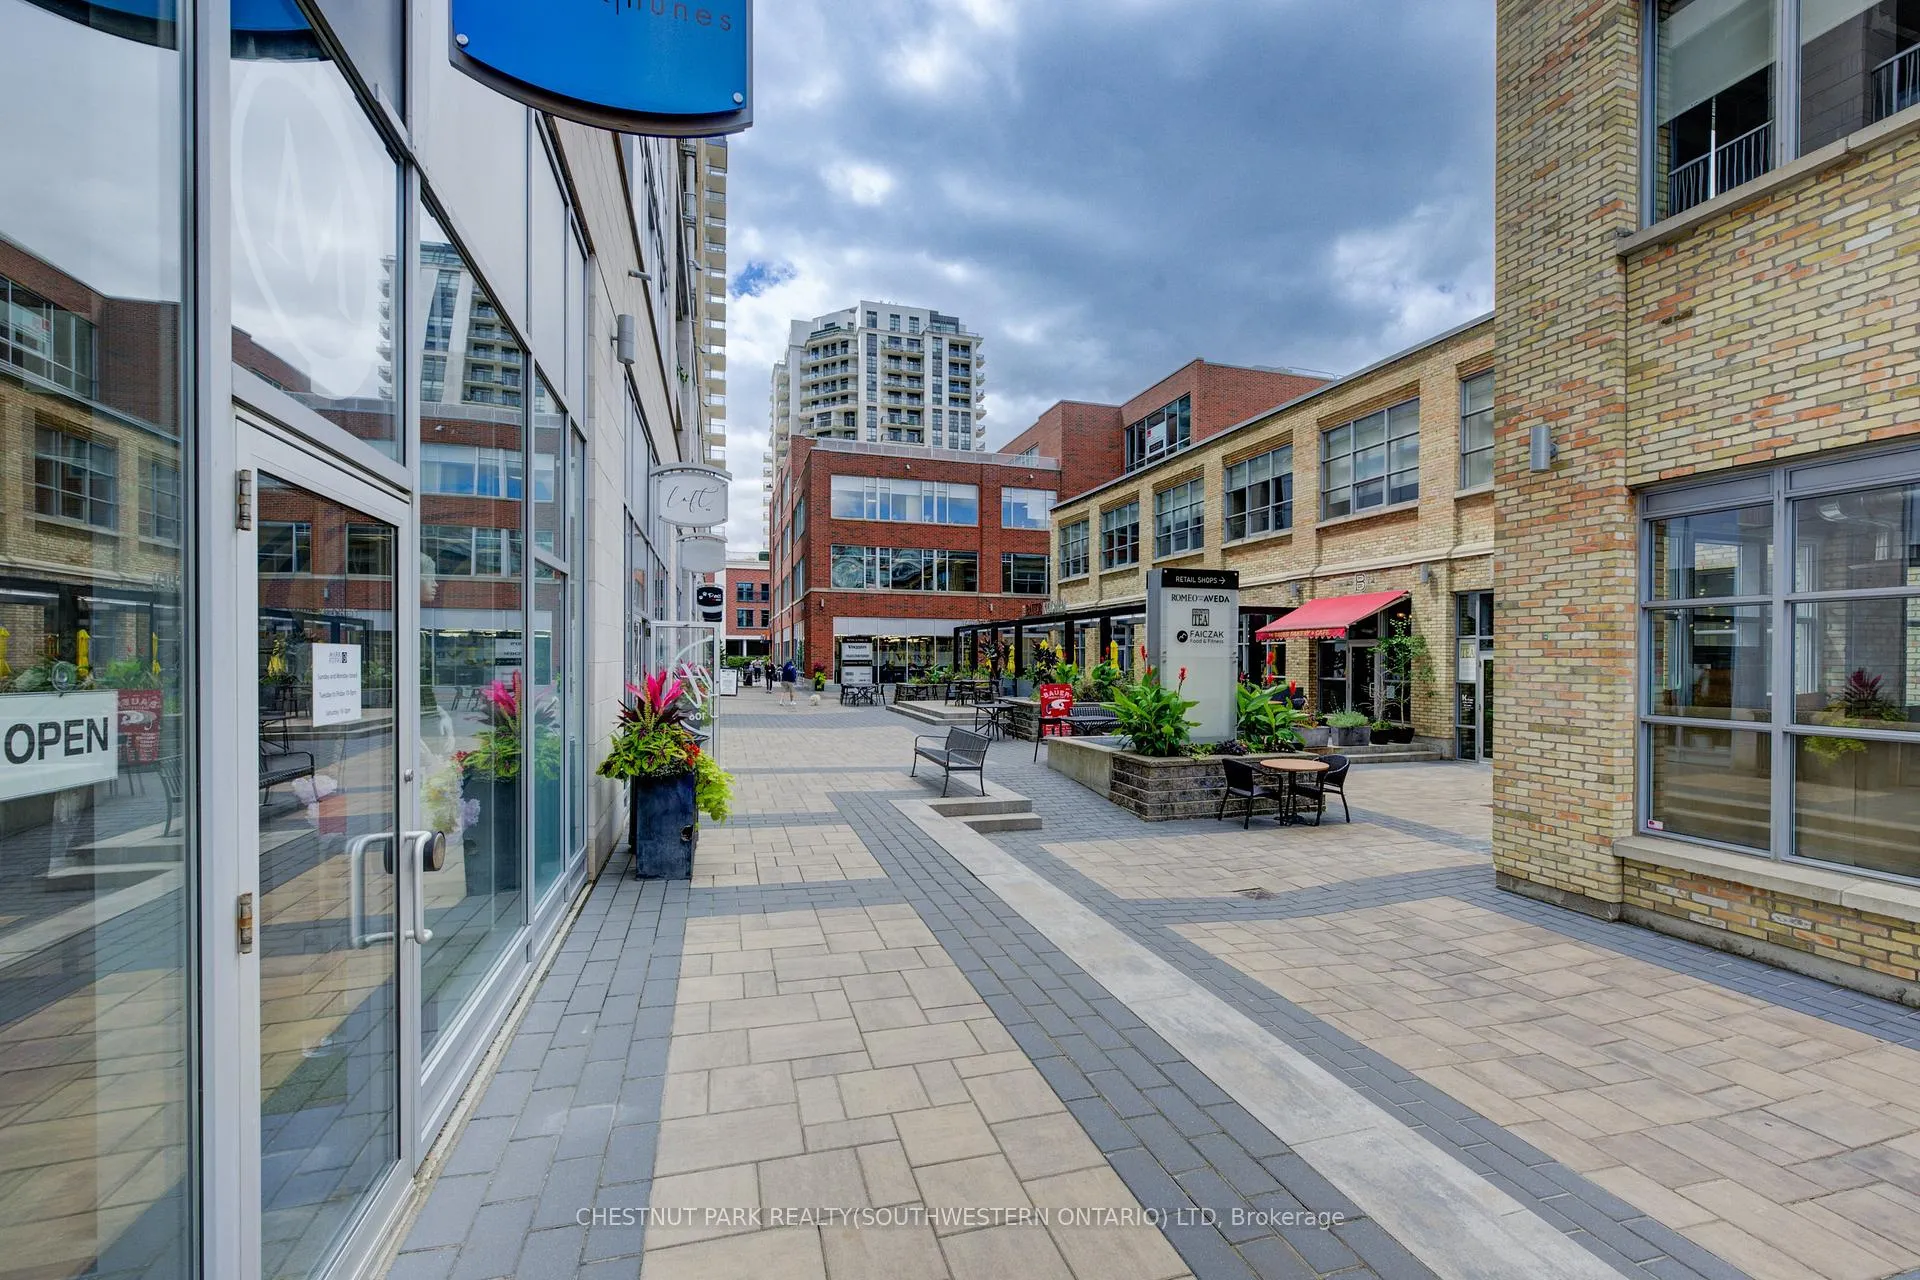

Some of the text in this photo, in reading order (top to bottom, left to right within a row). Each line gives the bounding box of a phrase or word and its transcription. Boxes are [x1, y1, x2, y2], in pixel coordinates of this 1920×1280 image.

[1197, 576, 1218, 584] SHOPS
[1171, 594, 1198, 602] ROMEO
[1203, 595, 1230, 603] AVEDA
[1193, 614, 1208, 626] TEA
[1043, 690, 1070, 699] BAUER
[4, 717, 108, 764] OPEN
